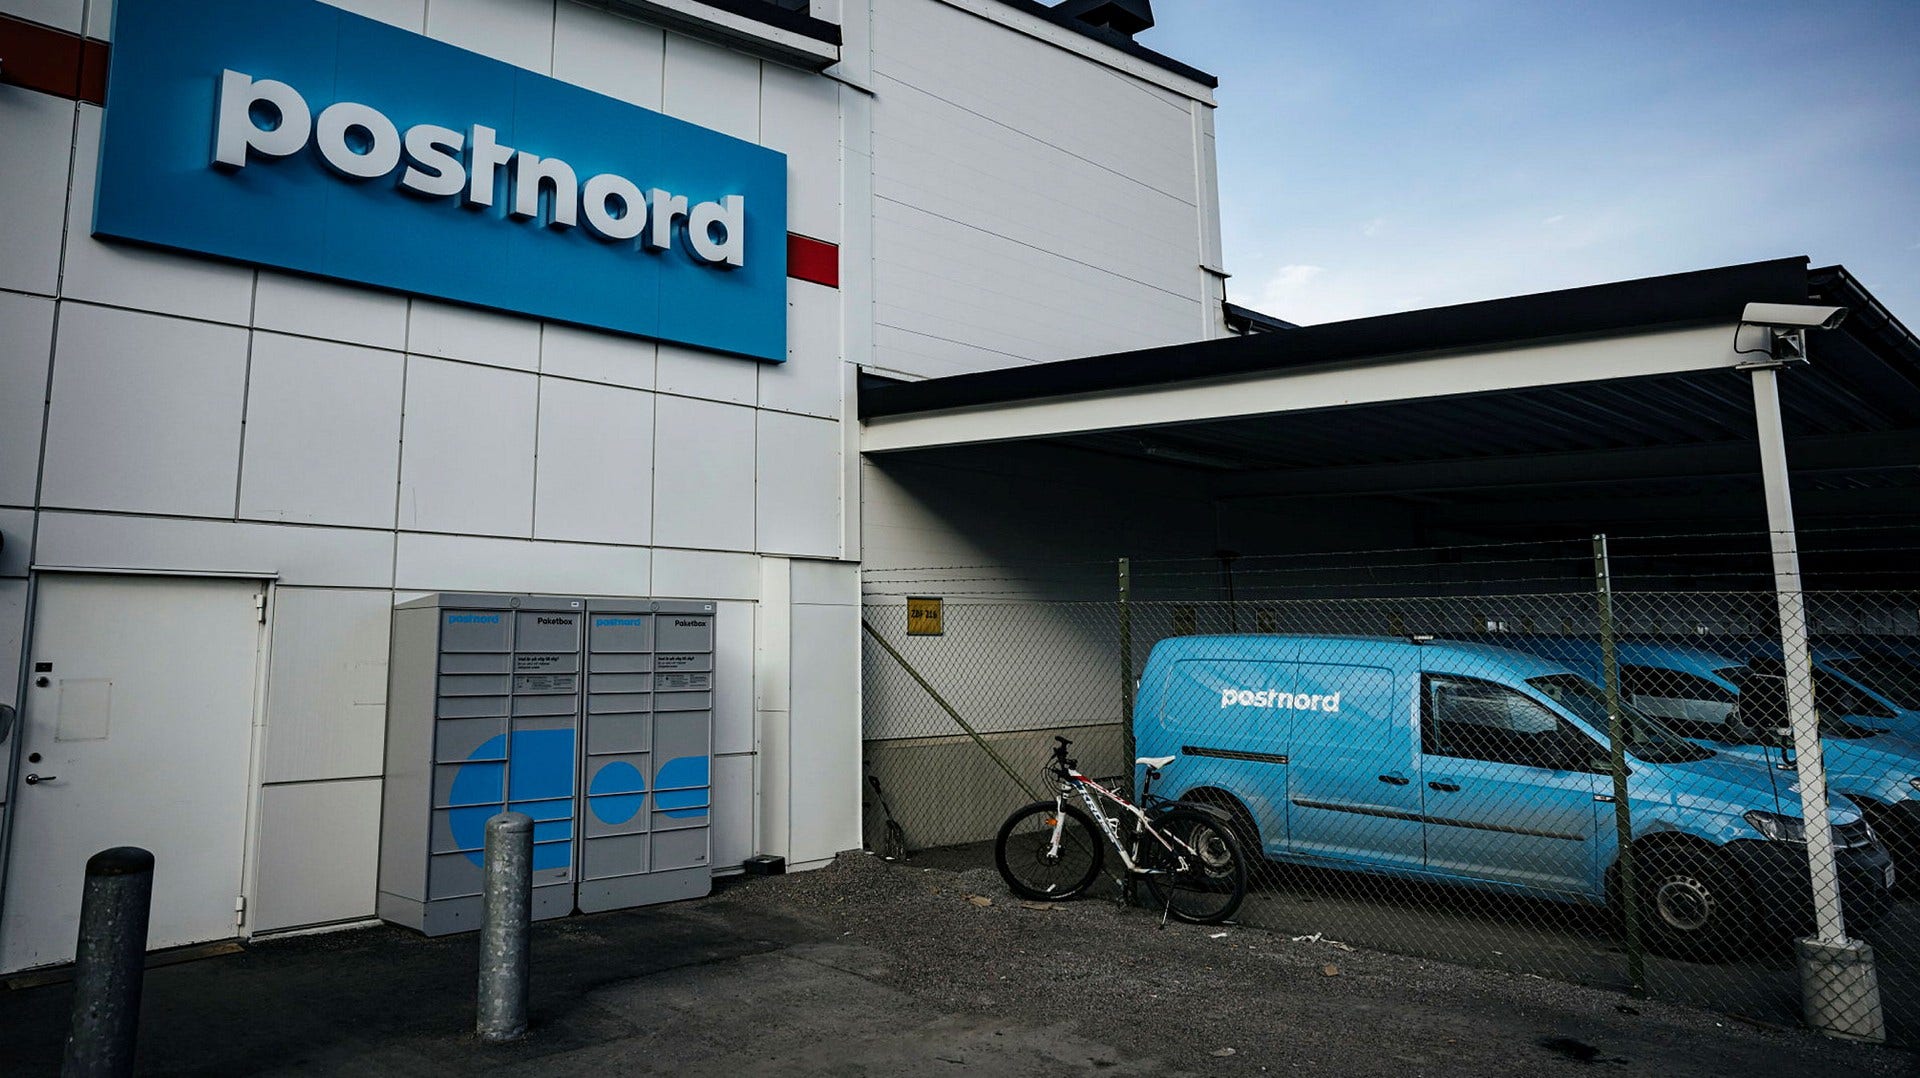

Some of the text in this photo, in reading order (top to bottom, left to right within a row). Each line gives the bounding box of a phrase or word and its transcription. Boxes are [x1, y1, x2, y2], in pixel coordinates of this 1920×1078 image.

[213, 68, 745, 267] postnord
[448, 614, 499, 625] postnord
[537, 616, 573, 625] Paketbox
[595, 618, 641, 627] postnord
[674, 619, 707, 627] Paketbox
[1221, 689, 1340, 712] postnord
